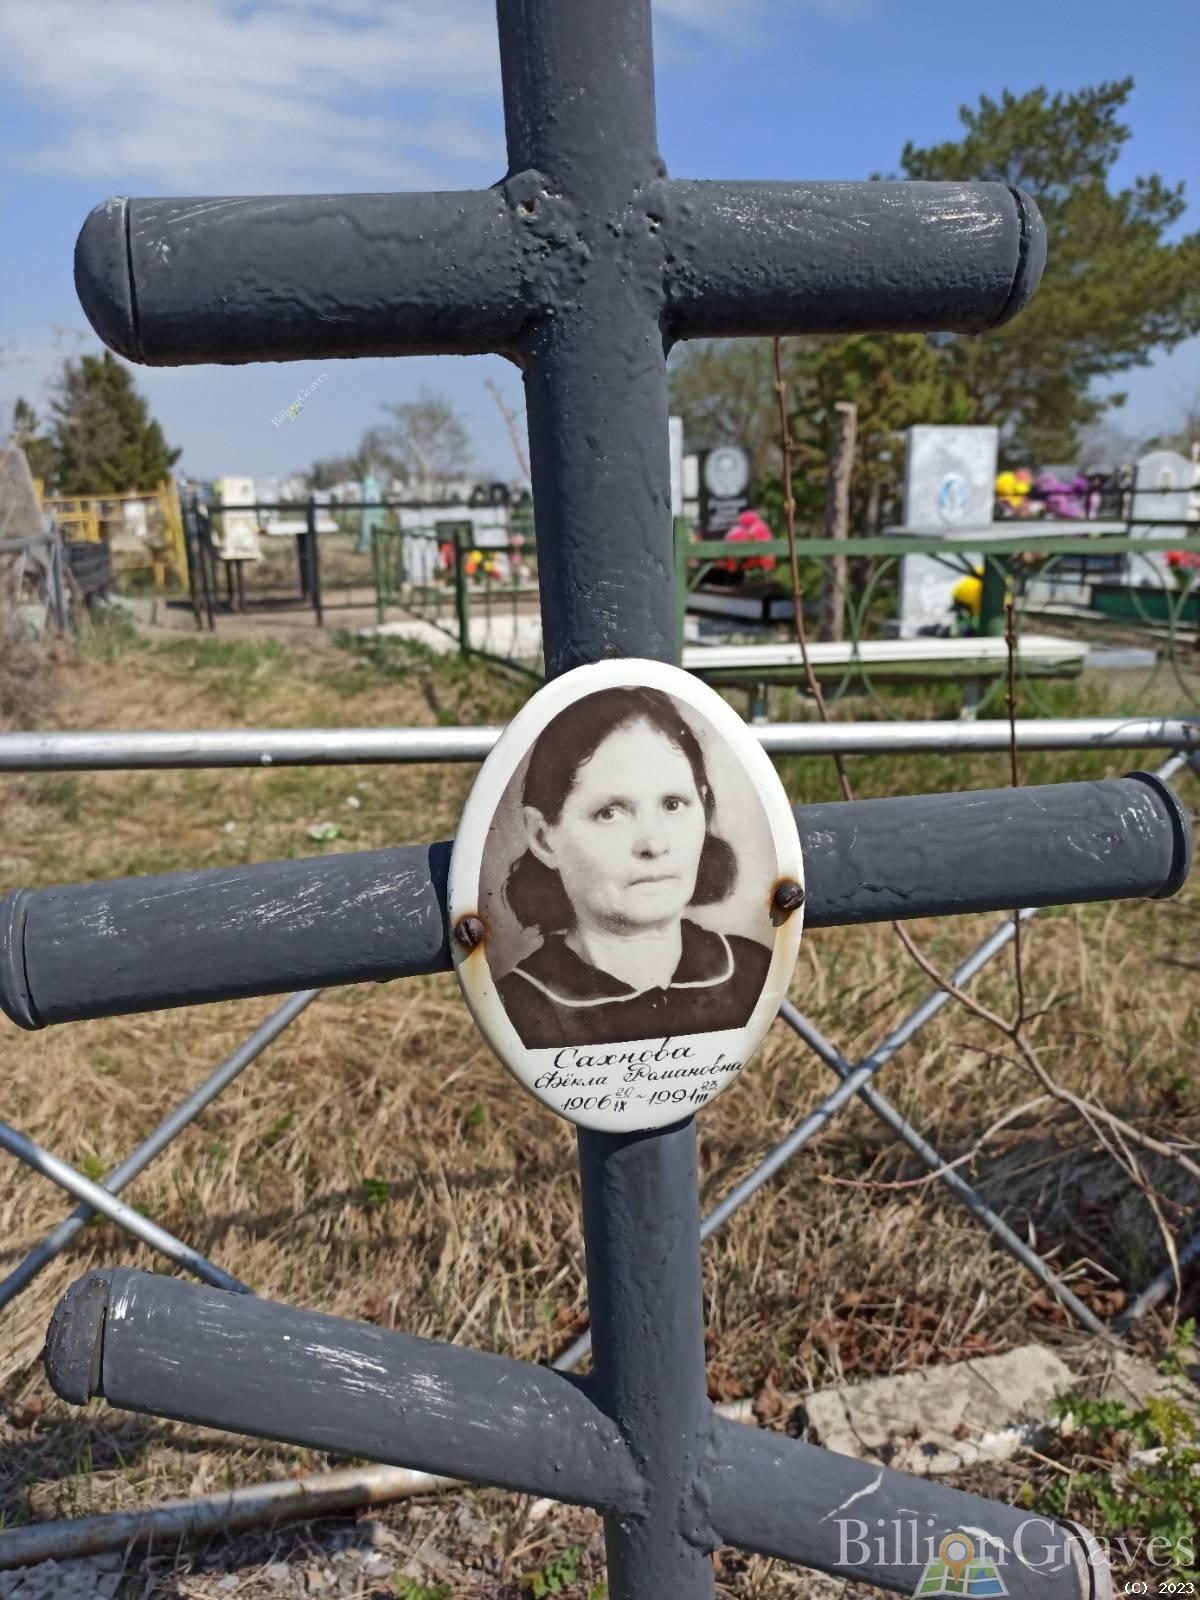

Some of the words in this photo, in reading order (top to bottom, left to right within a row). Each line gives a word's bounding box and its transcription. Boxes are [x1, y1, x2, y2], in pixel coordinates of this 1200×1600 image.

[554, 1036, 696, 1069] Сахнова
[534, 1071, 608, 1089] Фёкла
[561, 1094, 612, 1111] 1906
